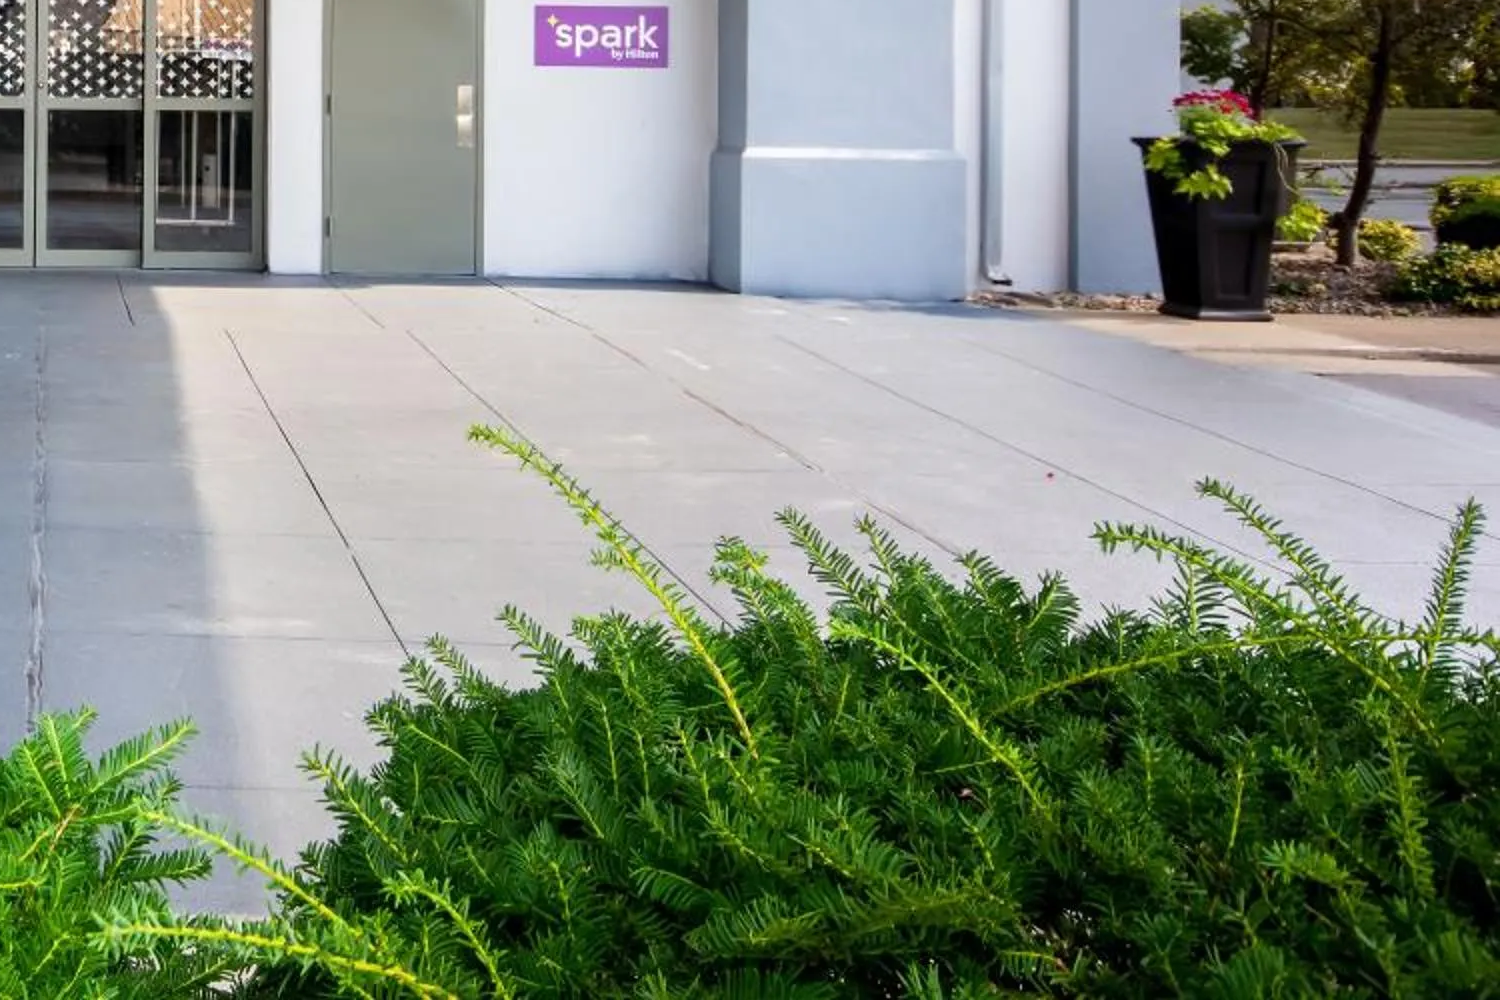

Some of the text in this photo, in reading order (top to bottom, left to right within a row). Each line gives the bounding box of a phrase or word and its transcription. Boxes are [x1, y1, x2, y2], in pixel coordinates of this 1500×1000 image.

[555, 15, 659, 57] spark
[611, 48, 659, 60] by Hilton
